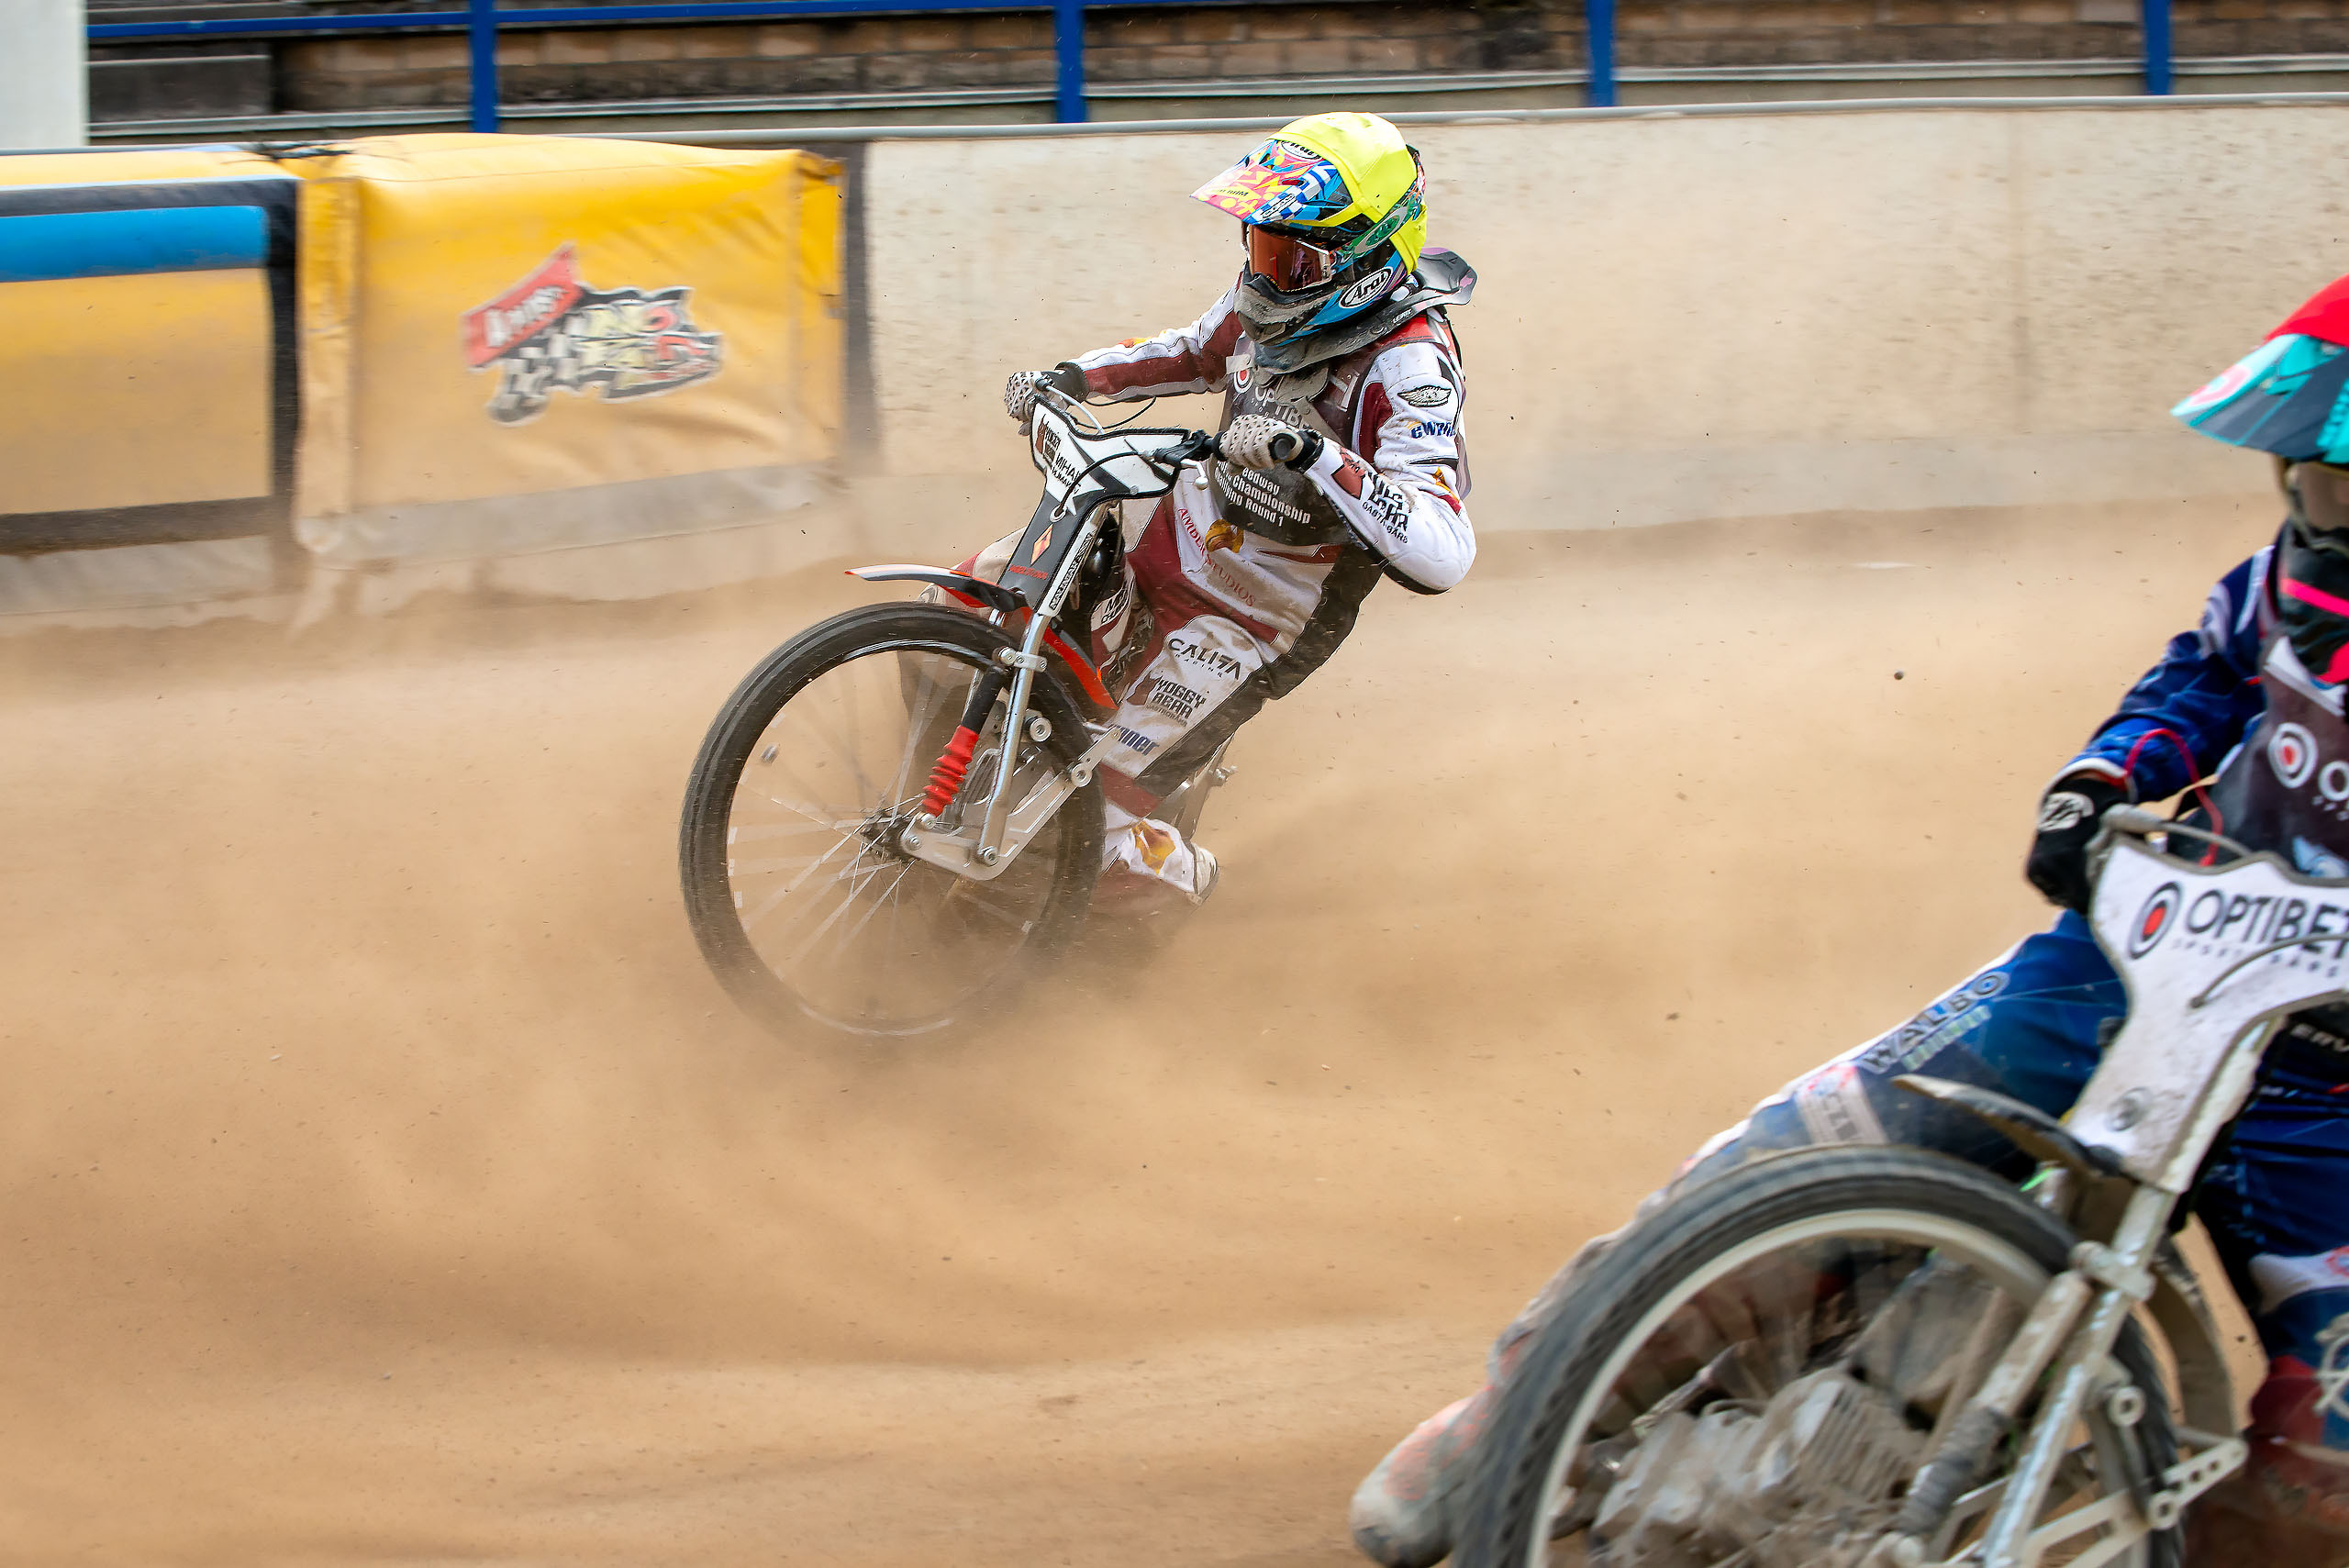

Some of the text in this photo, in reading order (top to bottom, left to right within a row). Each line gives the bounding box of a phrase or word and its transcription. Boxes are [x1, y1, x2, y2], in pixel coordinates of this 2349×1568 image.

[1352, 270, 1386, 299] Arai
[1232, 475, 1311, 524] Championship
[1244, 497, 1277, 524] Round
[1278, 515, 1285, 528] 1
